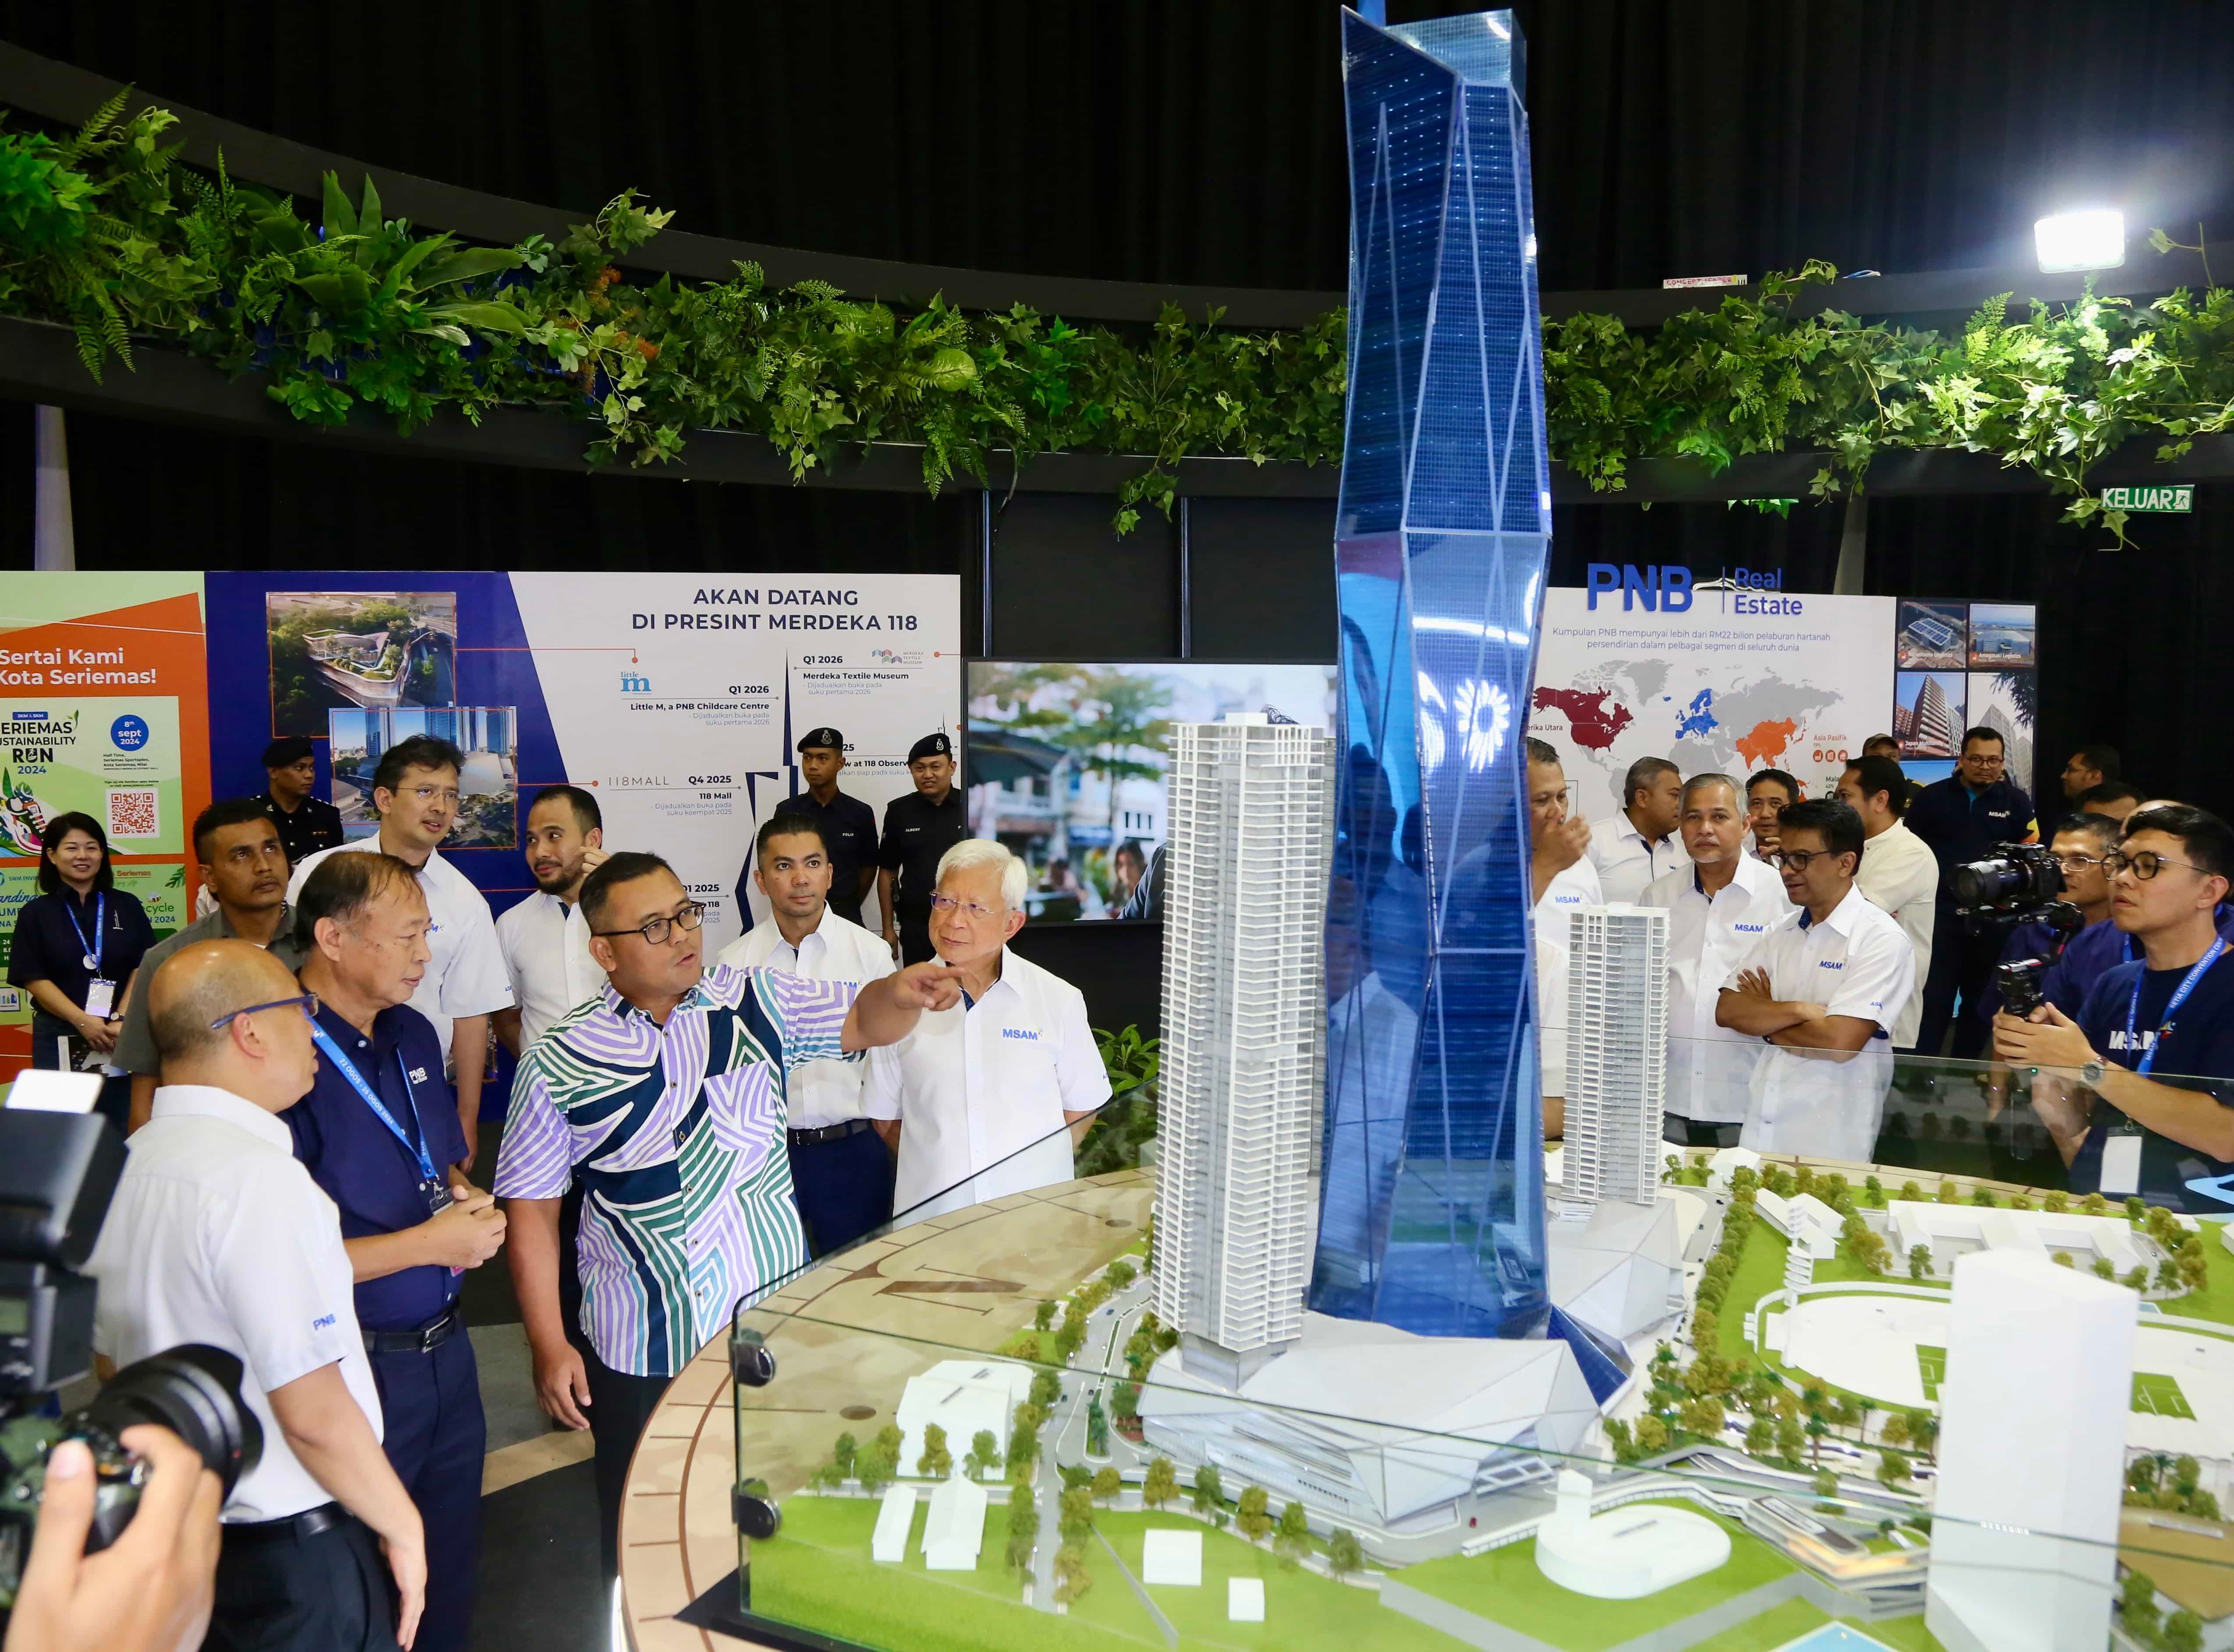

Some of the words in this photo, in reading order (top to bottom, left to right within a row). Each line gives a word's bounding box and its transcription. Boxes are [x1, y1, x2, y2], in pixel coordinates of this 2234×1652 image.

[2103, 488, 2174, 510] KELUAR
[1735, 567, 1781, 588] Real
[1587, 563, 1693, 613] PNB
[693, 589, 759, 604] AKAN
[768, 589, 858, 606] DATANG
[1735, 595, 1803, 615] Estate
[632, 614, 655, 629] DI
[664, 614, 761, 630] PRESINT
[769, 614, 881, 630] MERDEKA
[887, 615, 918, 631] 118
[1553, 627, 1596, 637] Kumpulan
[1599, 627, 1617, 637] PNB
[1619, 628, 1668, 639] mempunyai
[1670, 629, 1690, 638] lebih
[1692, 629, 1707, 638] dari
[1709, 630, 1731, 639] RM22
[1733, 630, 1754, 640] bilion
[1756, 631, 1795, 642] pelaburan
[1797, 632, 1830, 641] hartanah
[1587, 640, 1639, 650] persendirian
[1641, 640, 1665, 649] dalam
[1668, 641, 1702, 651] pelbagai
[1704, 643, 1736, 652] segmen
[1738, 642, 1745, 651] di
[1747, 643, 1776, 652] seluruh
[1778, 643, 1799, 652] dunia
[0, 647, 61, 665] Sertai
[68, 647, 124, 665] Kami
[803, 656, 816, 665] Q1
[50, 667, 156, 685] Seriemas!
[620, 678, 652, 691] m
[729, 685, 741, 695] Q1
[744, 685, 769, 694] 2026
[0, 722, 73, 734] ERIEMAS
[118, 730, 142, 739] sept
[0, 737, 76, 745] STAINABILITY
[12, 748, 53, 763] RUN
[17, 765, 47, 774] 2024
[688, 776, 704, 784] Q4
[707, 775, 731, 783] 2025
[695, 884, 720, 892] 2025
[1734, 923, 1763, 933] MSAM
[1819, 960, 1843, 971] MSAM
[2180, 980, 2192, 994] CITY
[2190, 949, 2217, 981] CONVENTION
[1002, 1028, 1038, 1041] MSAM
[408, 1067, 426, 1081] PNB
[339, 1058, 348, 1067] 22
[345, 1066, 362, 1085] OGOS
[367, 1094, 383, 1112] OGOS
[381, 1110, 394, 1125] 2024
[312, 1313, 336, 1331] PNB
